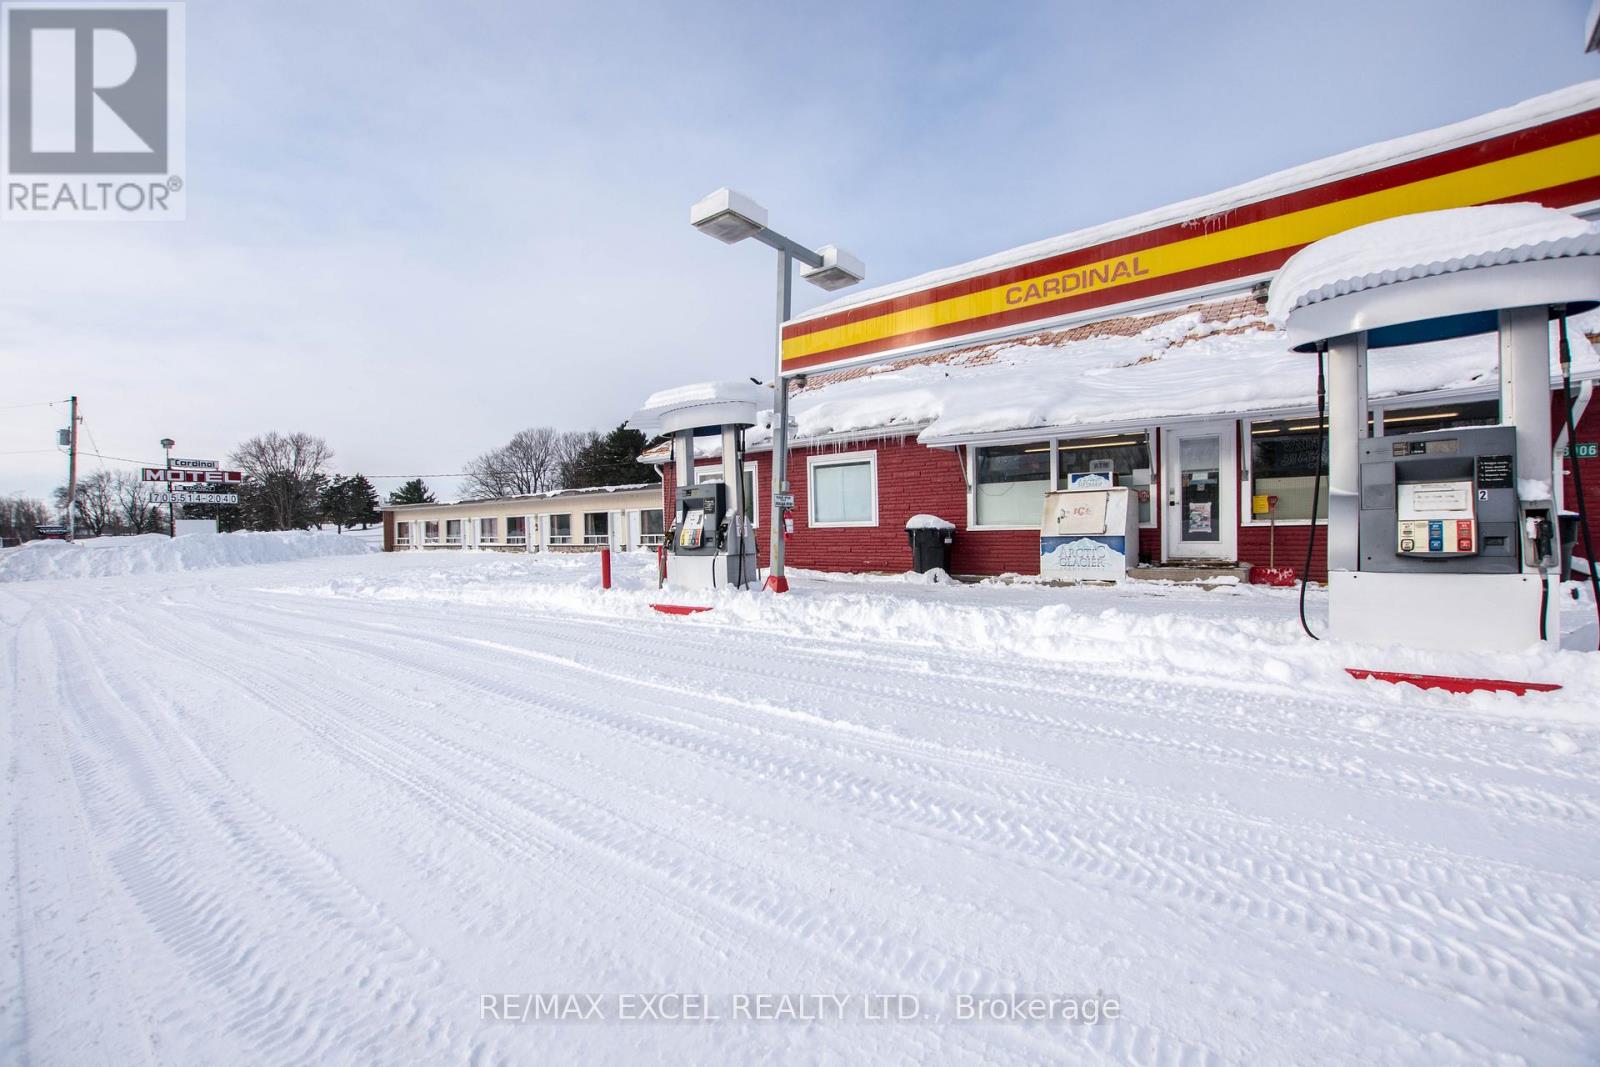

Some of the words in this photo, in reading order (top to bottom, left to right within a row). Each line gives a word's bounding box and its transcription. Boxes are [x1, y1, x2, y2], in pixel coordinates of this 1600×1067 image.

[1006, 256, 1149, 305] CARDINAL
[174, 459, 216, 468] Cardinal
[145, 468, 241, 483] MOTEL
[1479, 490, 1487, 500] 2
[1059, 545, 1107, 559] ARCTIC
[1059, 557, 1106, 568] GLACIER
